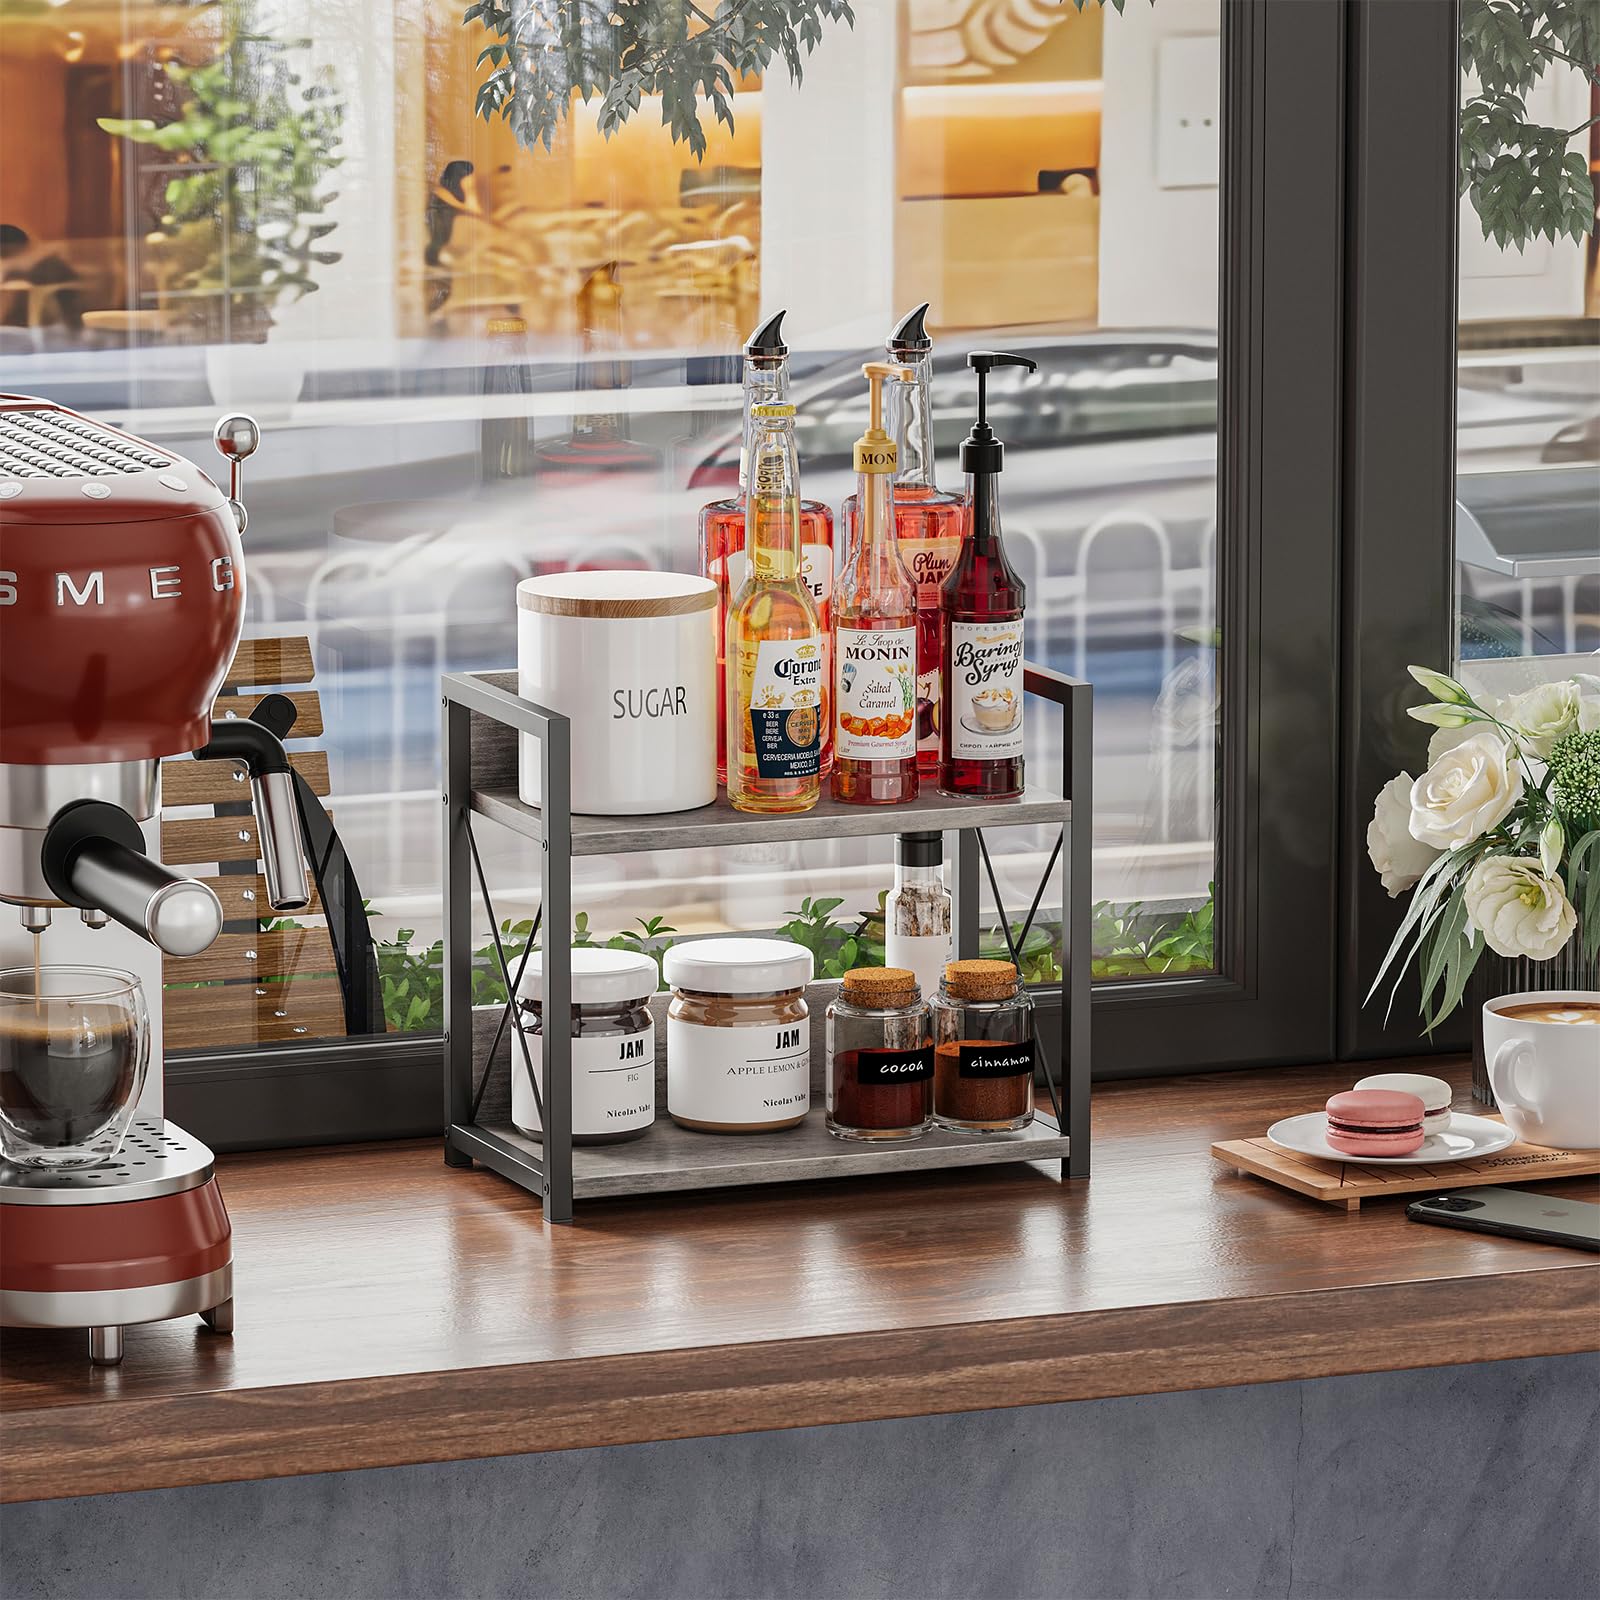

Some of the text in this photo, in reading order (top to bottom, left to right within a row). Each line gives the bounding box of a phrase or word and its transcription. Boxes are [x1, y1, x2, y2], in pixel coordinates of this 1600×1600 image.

[913, 552, 951, 573] Plum
[0, 556, 235, 606] SMEG
[846, 646, 908, 660] MONIN
[965, 658, 1018, 686] Syrup
[794, 675, 816, 685] Extra
[867, 680, 892, 694] Salted
[613, 686, 687, 719] SUGAR
[859, 691, 896, 709] Caramel
[776, 1029, 800, 1049] JAM
[619, 1039, 644, 1060] JAM
[726, 1066, 765, 1075] APPLE
[767, 1062, 795, 1074] LEMON
[879, 1060, 924, 1074] cocoa
[970, 1055, 1031, 1068] cinnamon
[627, 1073, 639, 1082] FIG
[763, 1097, 793, 1107] Nicolas
[607, 1108, 636, 1119] Nicolas
